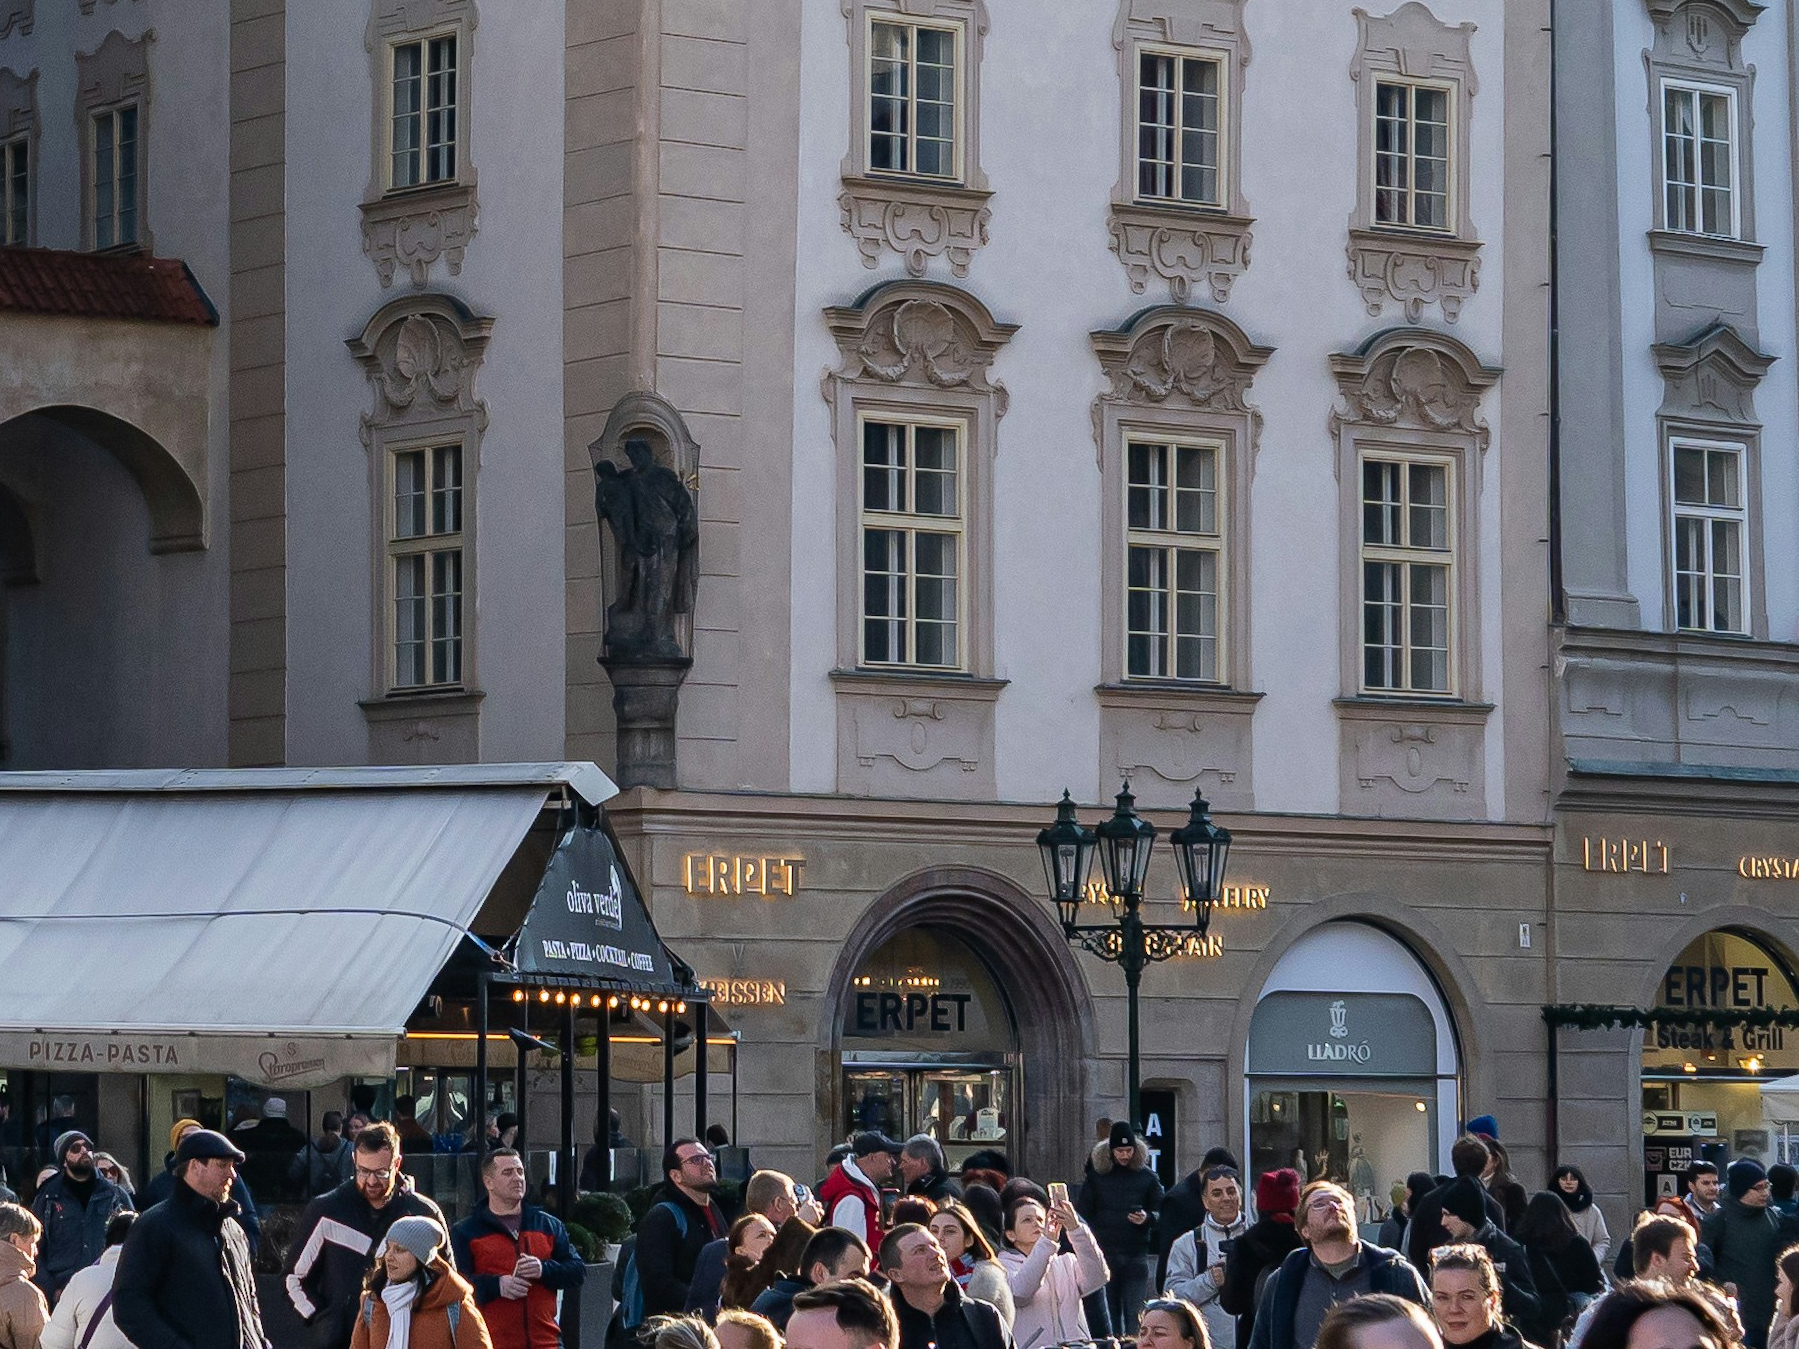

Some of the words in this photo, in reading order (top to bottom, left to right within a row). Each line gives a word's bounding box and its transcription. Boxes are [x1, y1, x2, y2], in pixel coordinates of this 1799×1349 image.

[686, 855, 807, 896] ERPET
[566, 879, 594, 914] oliva
[593, 885, 619, 920] verde
[542, 939, 567, 960] PASTA
[569, 941, 593, 962] PIZZA
[700, 979, 787, 1005] EISSEN
[1664, 965, 1769, 1007] ERPET
[856, 991, 972, 1032] ERPET
[1657, 1024, 1715, 1050] Steak
[1742, 1026, 1783, 1050] Grill
[29, 1041, 179, 1066] PIZZA-PASTA
[1668, 1147, 1692, 1159] EUR
